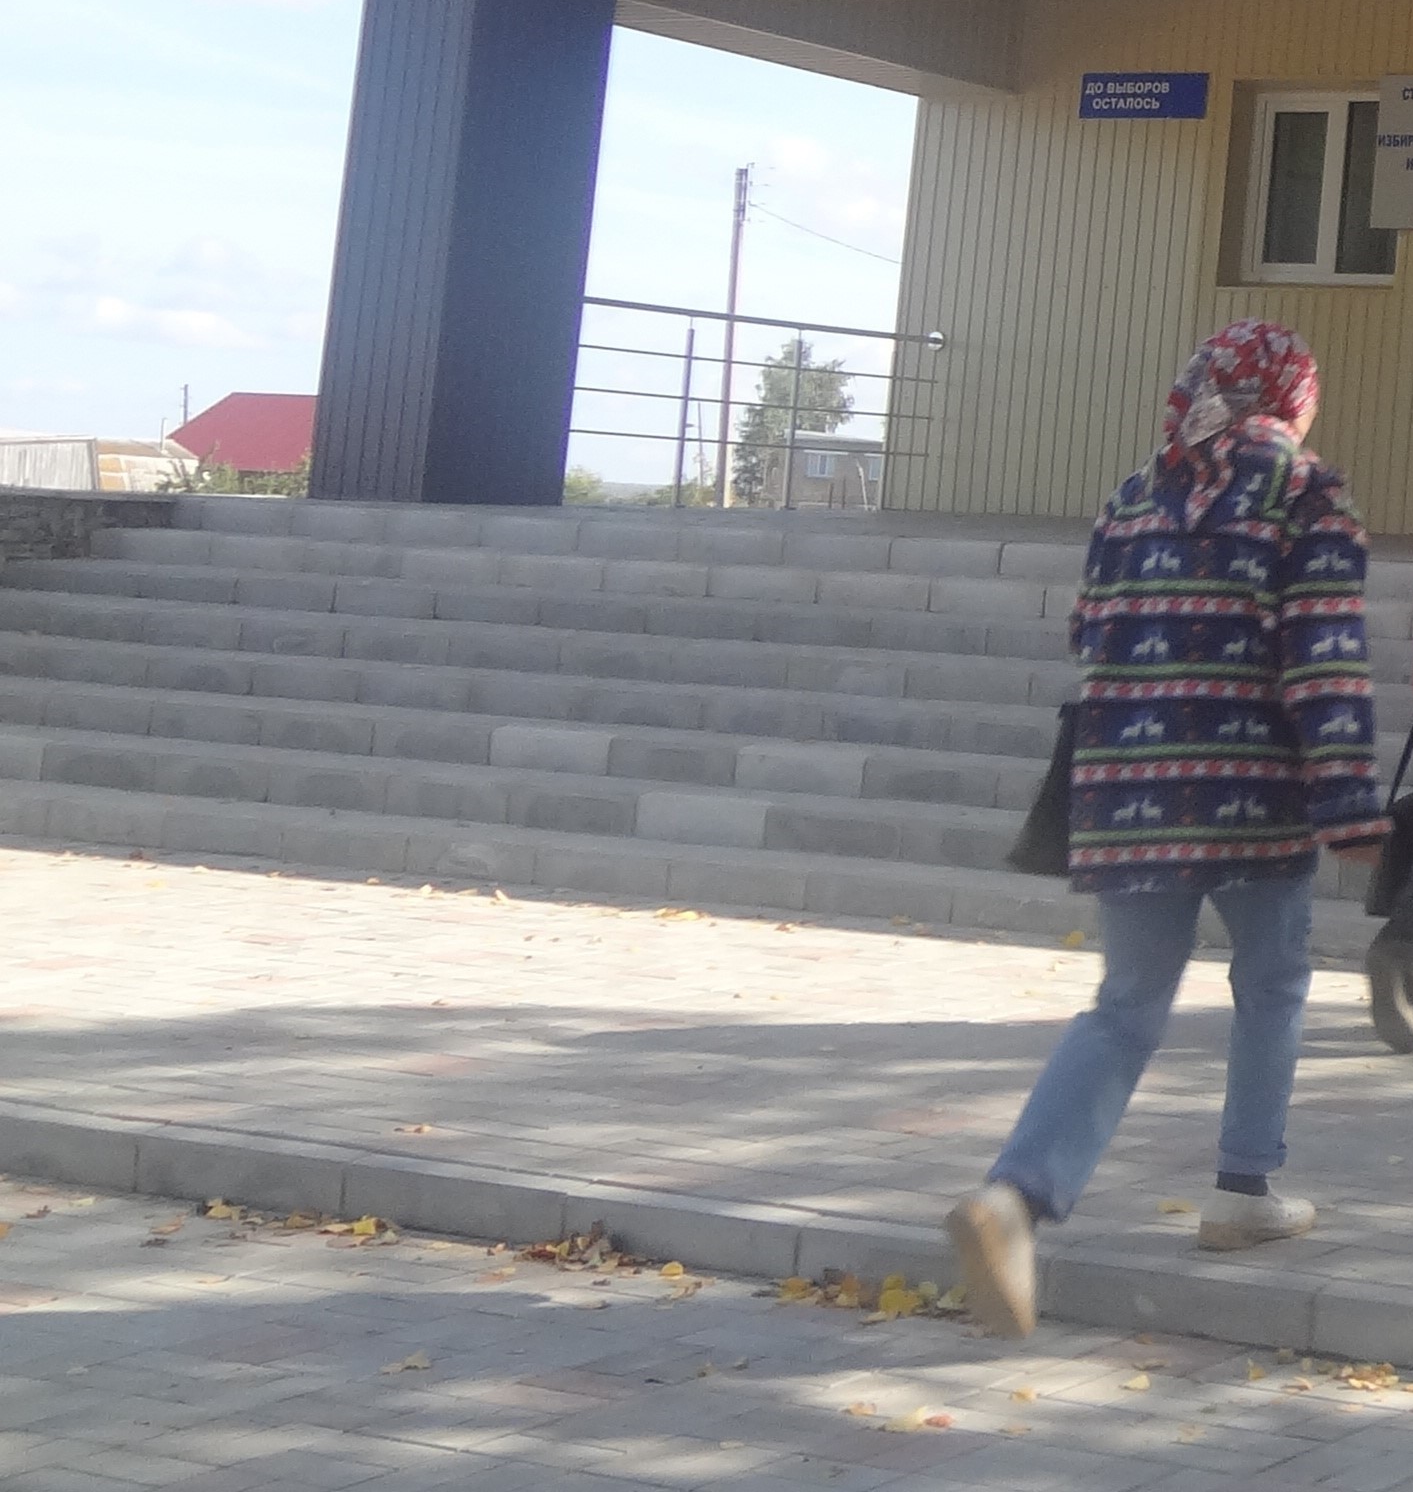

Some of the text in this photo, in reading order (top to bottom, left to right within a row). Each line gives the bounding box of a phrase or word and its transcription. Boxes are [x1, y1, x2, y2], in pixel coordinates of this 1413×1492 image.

[1085, 82, 1170, 95] ДО ВЫБОРОВ
[1092, 98, 1160, 109] ОСТАЛОСЬ
